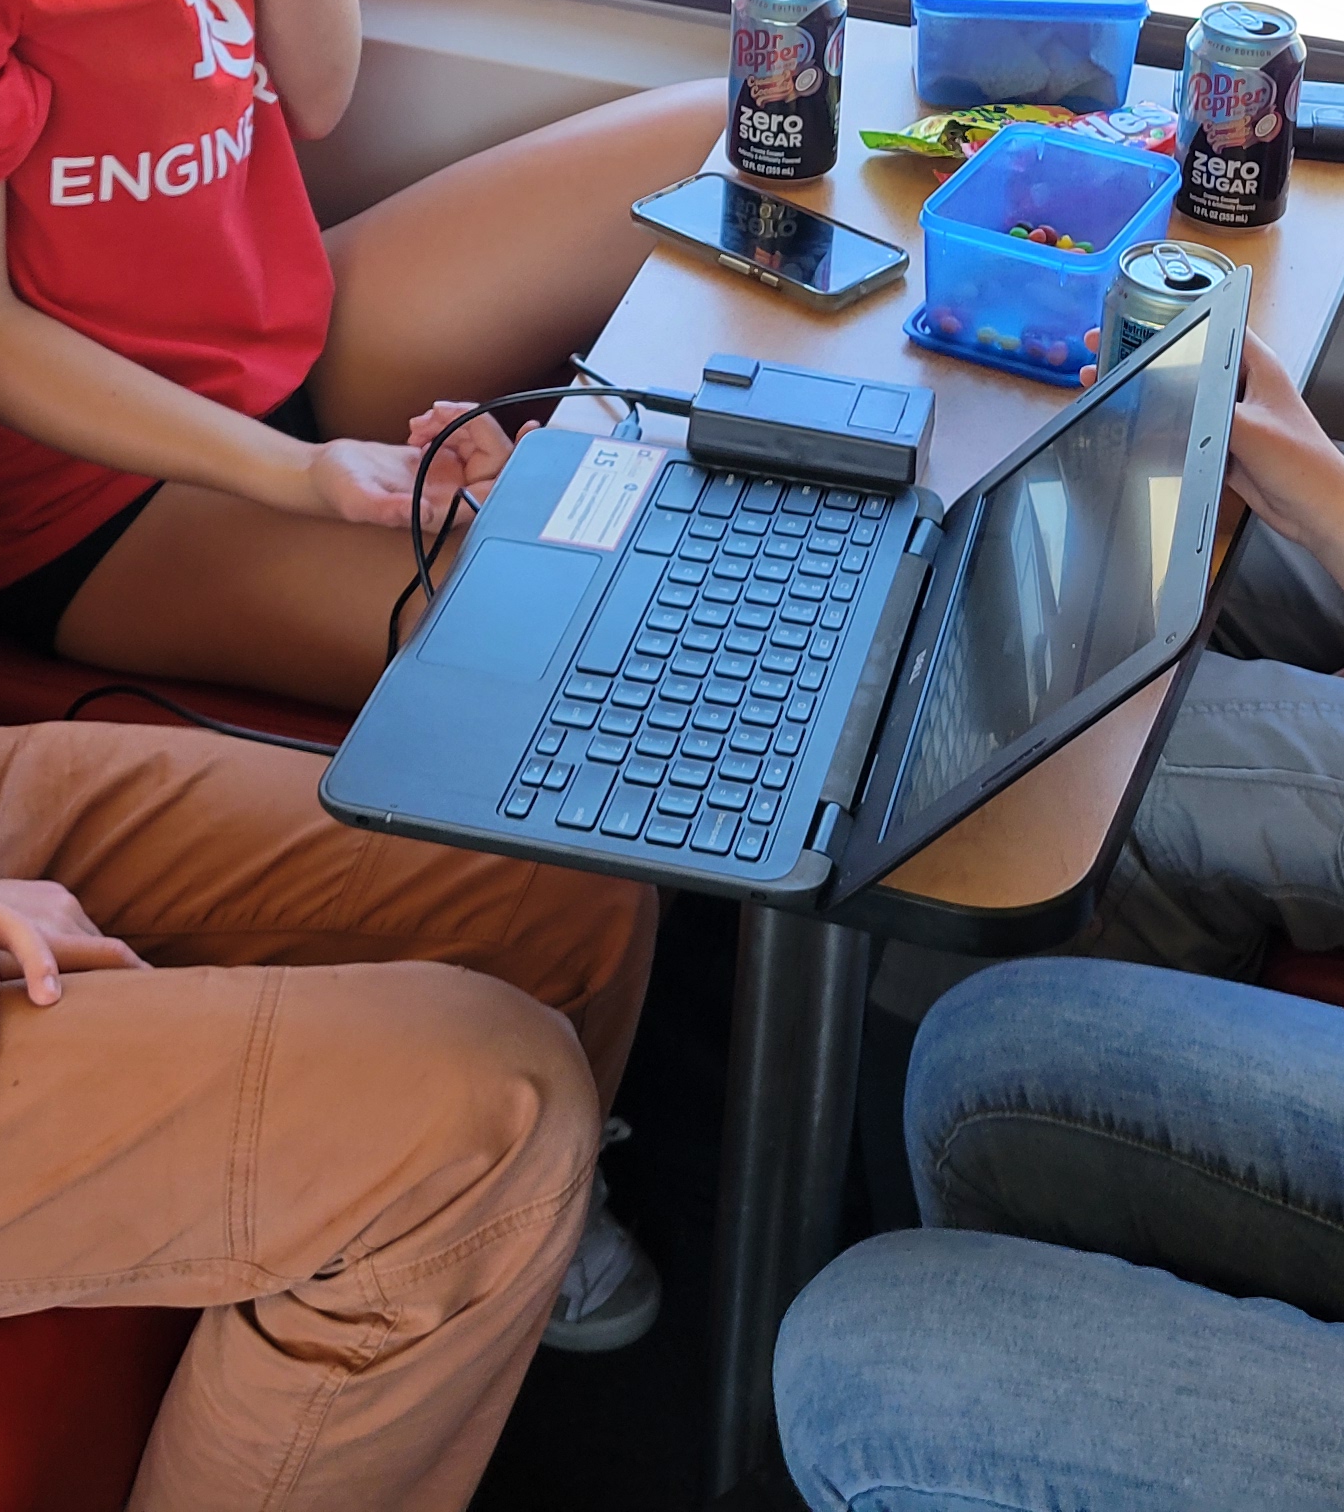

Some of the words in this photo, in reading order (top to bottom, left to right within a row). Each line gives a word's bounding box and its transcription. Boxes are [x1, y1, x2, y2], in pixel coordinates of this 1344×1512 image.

[735, 29, 805, 73] Pepper
[754, 29, 784, 50] Dr
[1188, 73, 1265, 118] Pepper
[1213, 73, 1247, 95] Dr
[739, 105, 804, 134] zero
[738, 124, 803, 148] SUGAR
[1192, 151, 1260, 180] zero
[1191, 172, 1258, 195] SUGAR
[594, 449, 619, 468] 15
